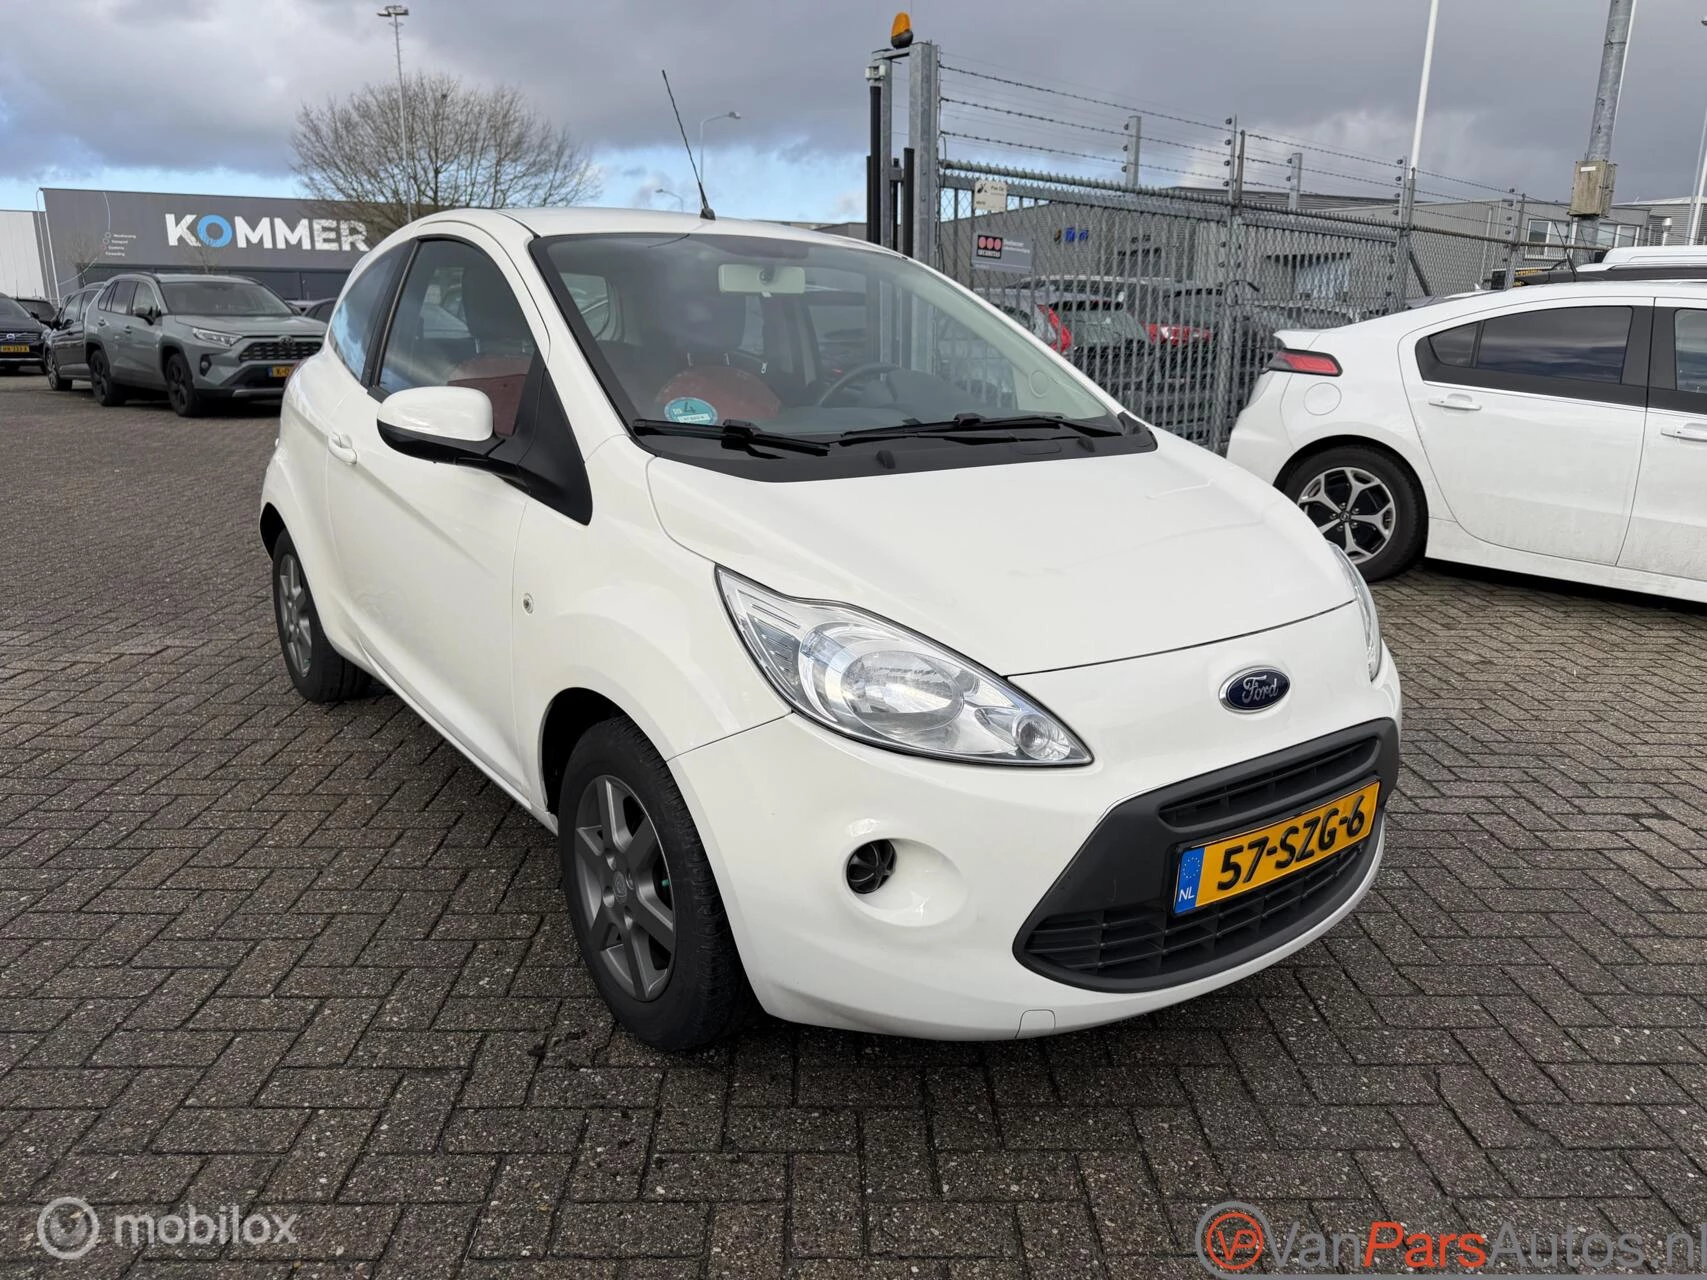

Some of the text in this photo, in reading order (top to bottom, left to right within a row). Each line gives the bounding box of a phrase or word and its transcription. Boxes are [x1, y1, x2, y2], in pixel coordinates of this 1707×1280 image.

[165, 213, 371, 252] KOMMER
[1241, 674, 1279, 704] Ford
[1217, 795, 1366, 891] 57-SZG-6
[1178, 887, 1195, 902] NL
